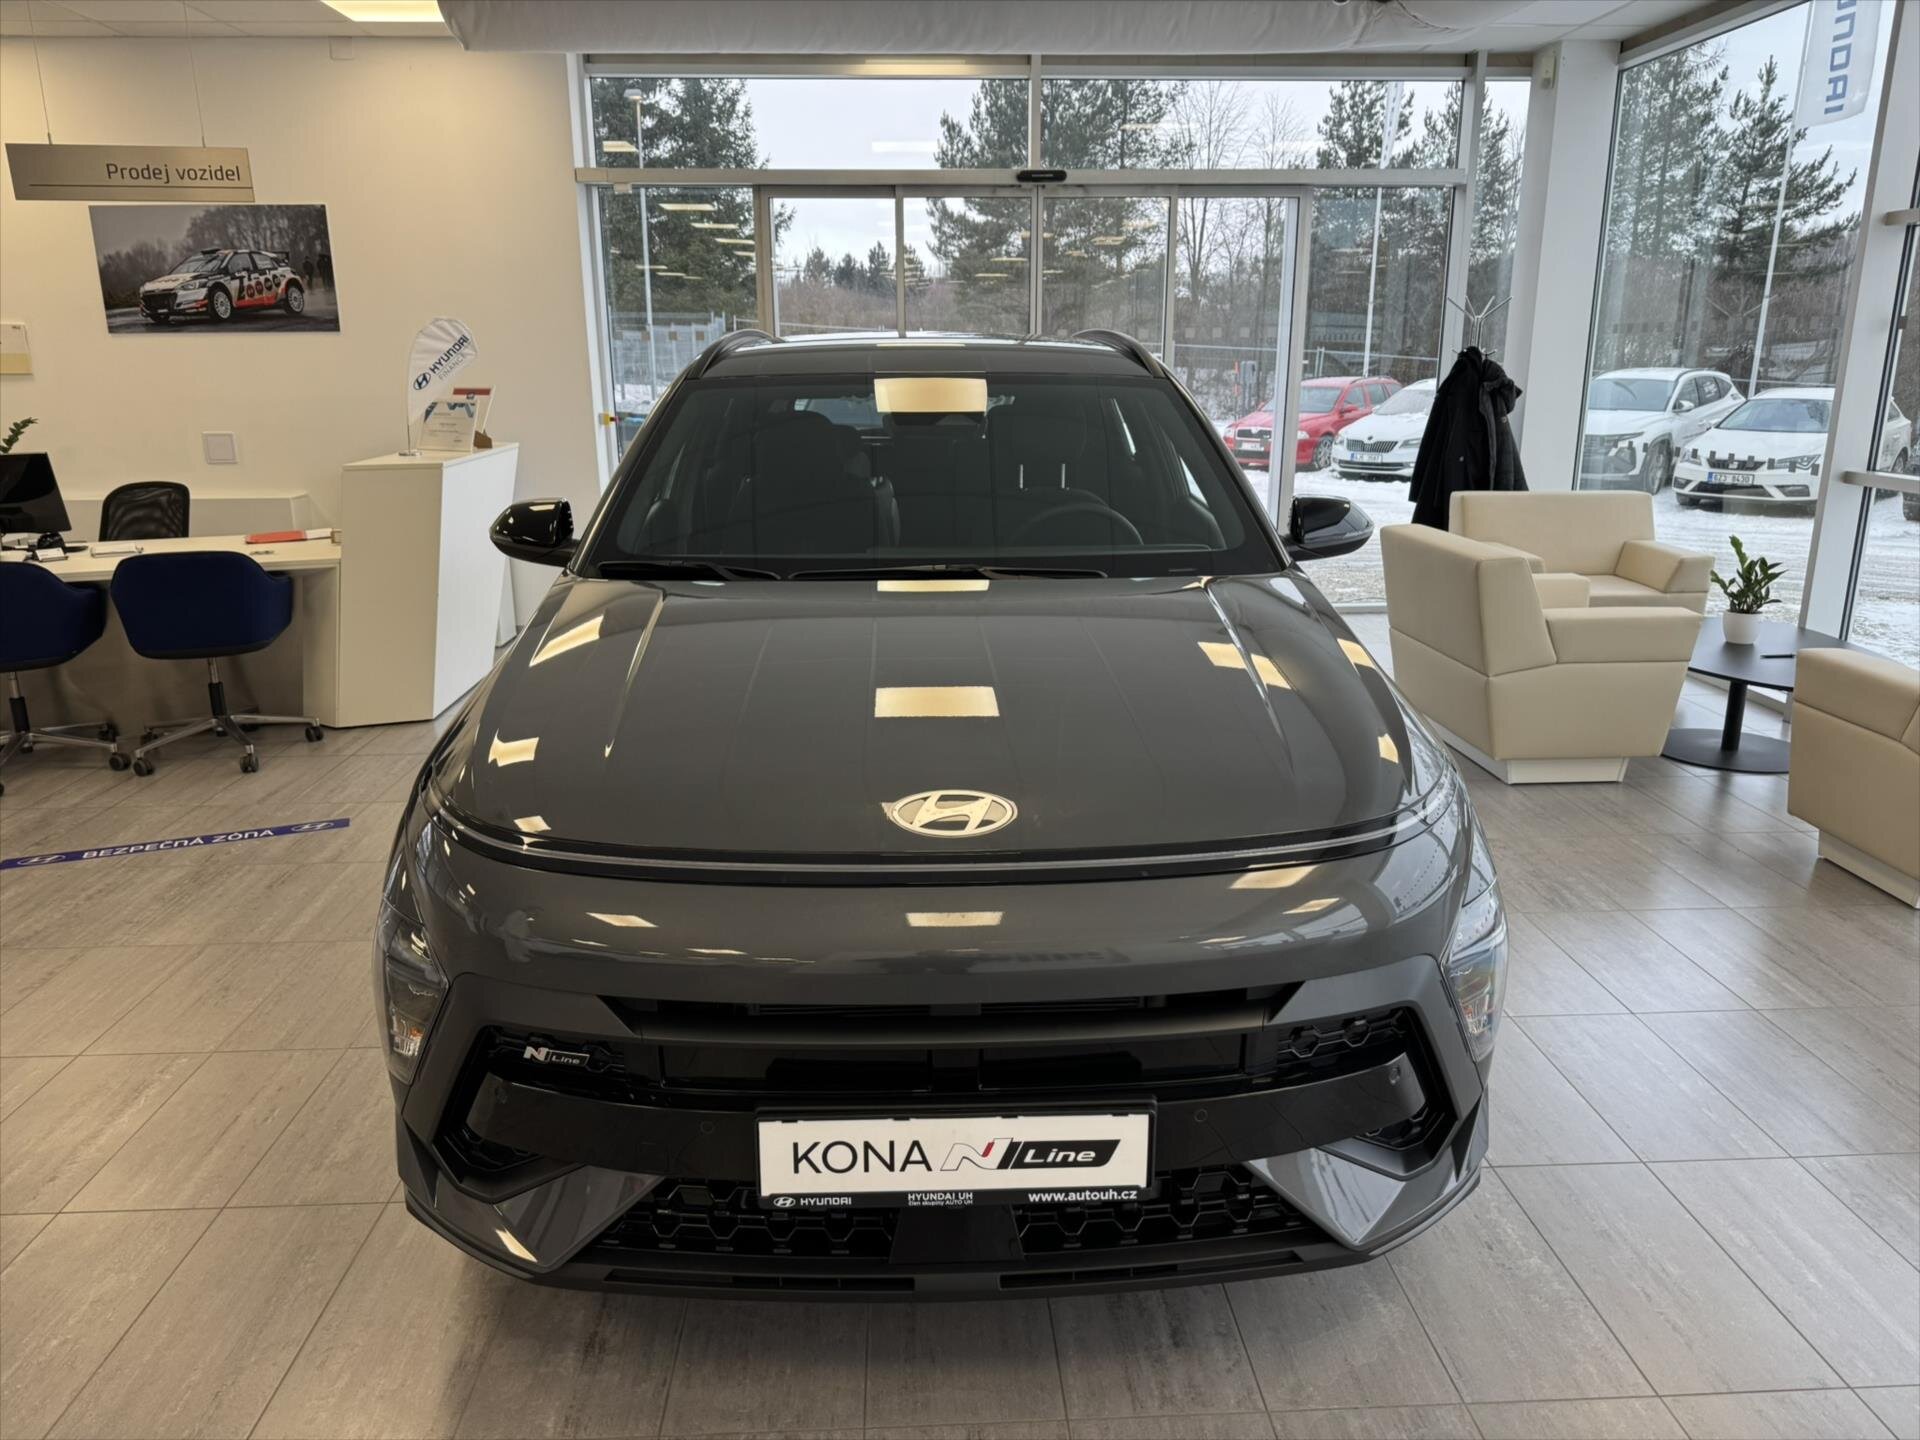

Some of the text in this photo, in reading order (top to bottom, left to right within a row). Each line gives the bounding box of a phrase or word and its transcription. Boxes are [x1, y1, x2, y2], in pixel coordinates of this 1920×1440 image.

[106, 163, 240, 184] Prodej vozidel
[429, 334, 470, 374] HYUNDAI
[551, 1055, 580, 1064] Line
[793, 1138, 1096, 1174] KONA N Line
[800, 1197, 852, 1206] HYUNDAI
[908, 1192, 973, 1201] HYUNDAI UH
[1028, 1189, 1138, 1202] www.autouh.cz
